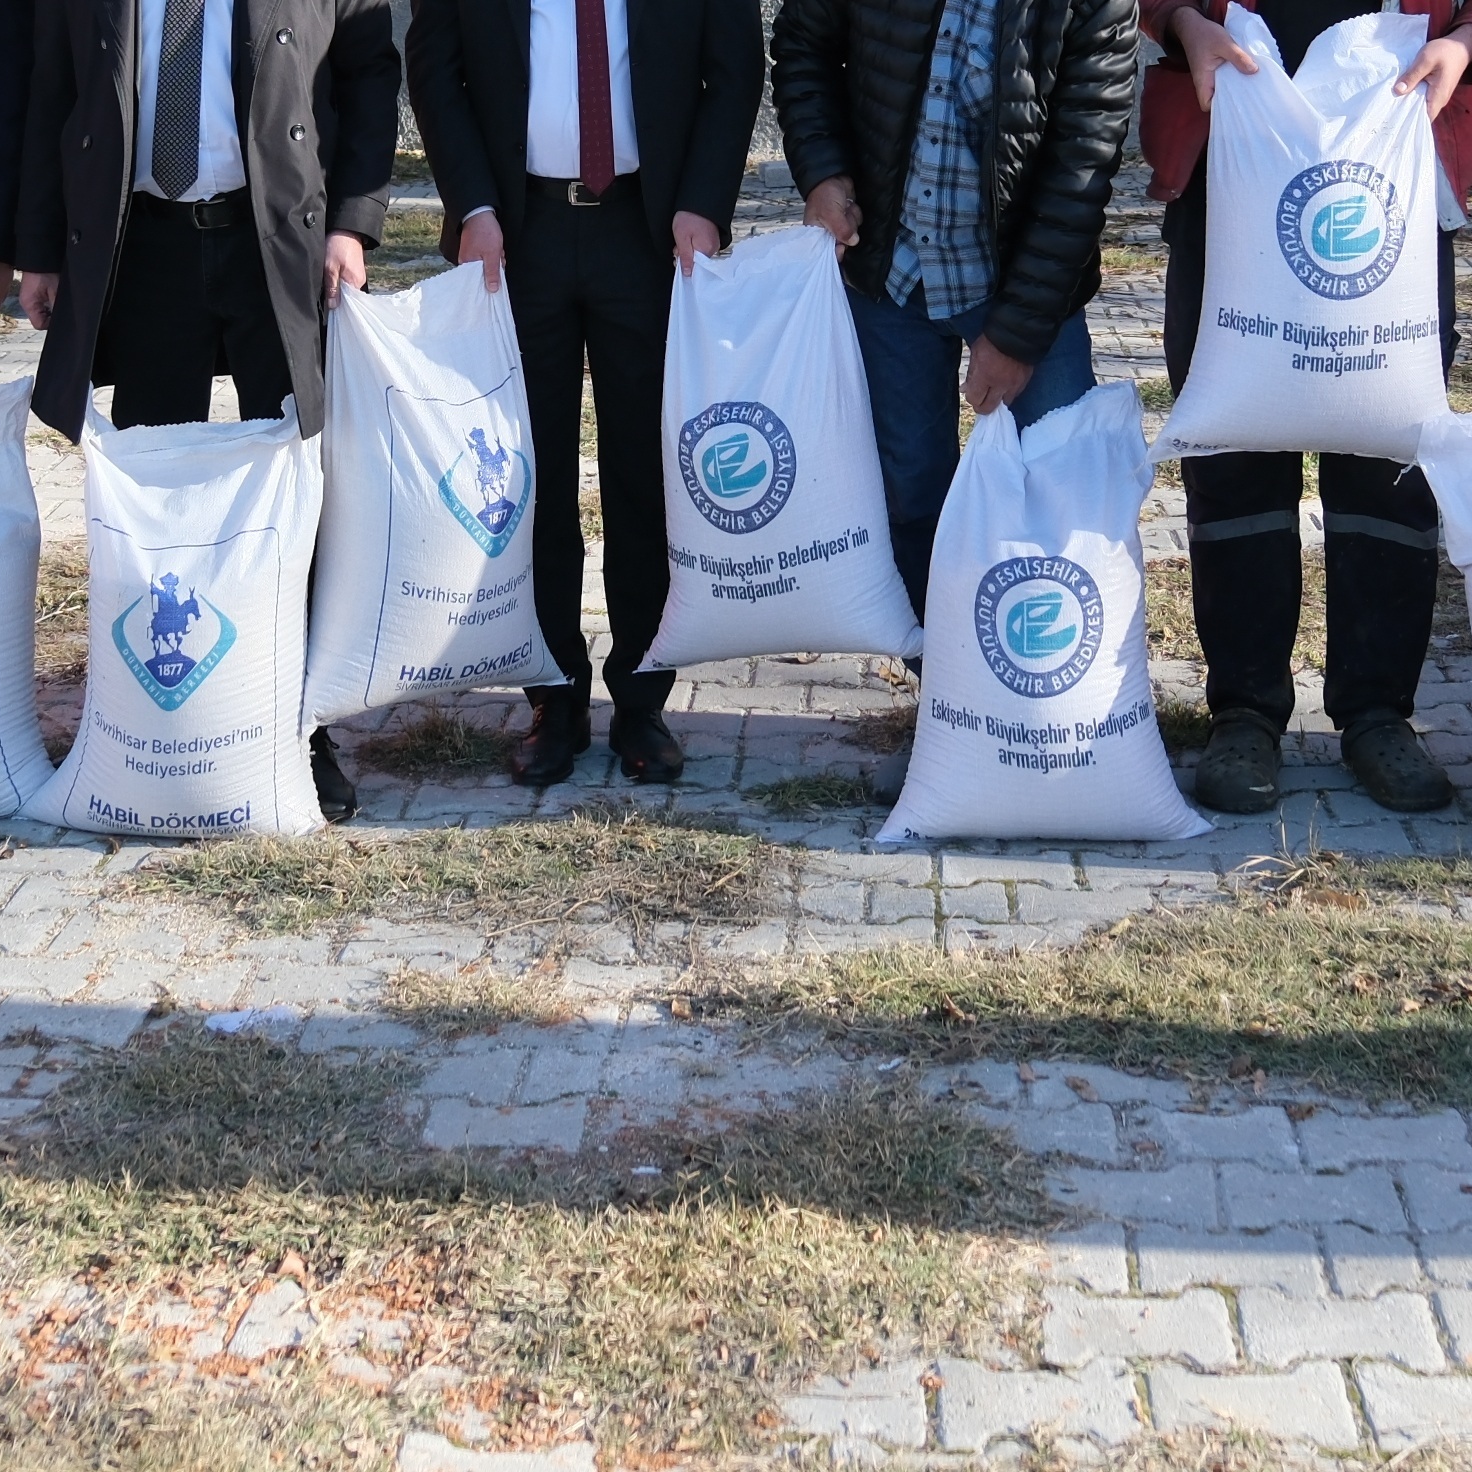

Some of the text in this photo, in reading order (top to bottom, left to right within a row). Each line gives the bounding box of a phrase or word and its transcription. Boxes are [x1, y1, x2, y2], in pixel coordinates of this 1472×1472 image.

[1281, 202, 1349, 296] BÜYÜKŞEHİR
[1217, 307, 1278, 338] Eskişehir
[1283, 321, 1369, 352] Büyükşehir
[1292, 349, 1388, 377] armağanıdır.
[694, 405, 763, 434] ESKİŞEHİR
[680, 434, 792, 530] BÜYÜKŞEHİR BELEDİYESİ
[488, 509, 508, 525] 1877
[700, 554, 774, 582] Büyükşehir
[778, 526, 870, 571] Belediyesi'nin
[995, 560, 1081, 587] ESKİŞEHİR
[400, 581, 472, 605] Sivrihisar
[712, 575, 800, 604] armağanıdır.
[447, 599, 519, 626] Hediyesidir.
[399, 634, 532, 681] HABİL DÖKMECİ
[978, 595, 1100, 694] BÜYÜKŞEHİR BELEDİYESİ
[122, 648, 167, 704] DÜNYANIN
[157, 663, 184, 676] 1877
[94, 711, 264, 754] Sivrihisar Belediyesi'nin
[932, 698, 1149, 749] Eskişehir Büyükşehir Belediyesi'nin
[125, 754, 218, 778] Hediyesidir.
[998, 746, 1097, 774] armağanıdır.
[90, 794, 250, 828] HABİL DÖKMECİ
